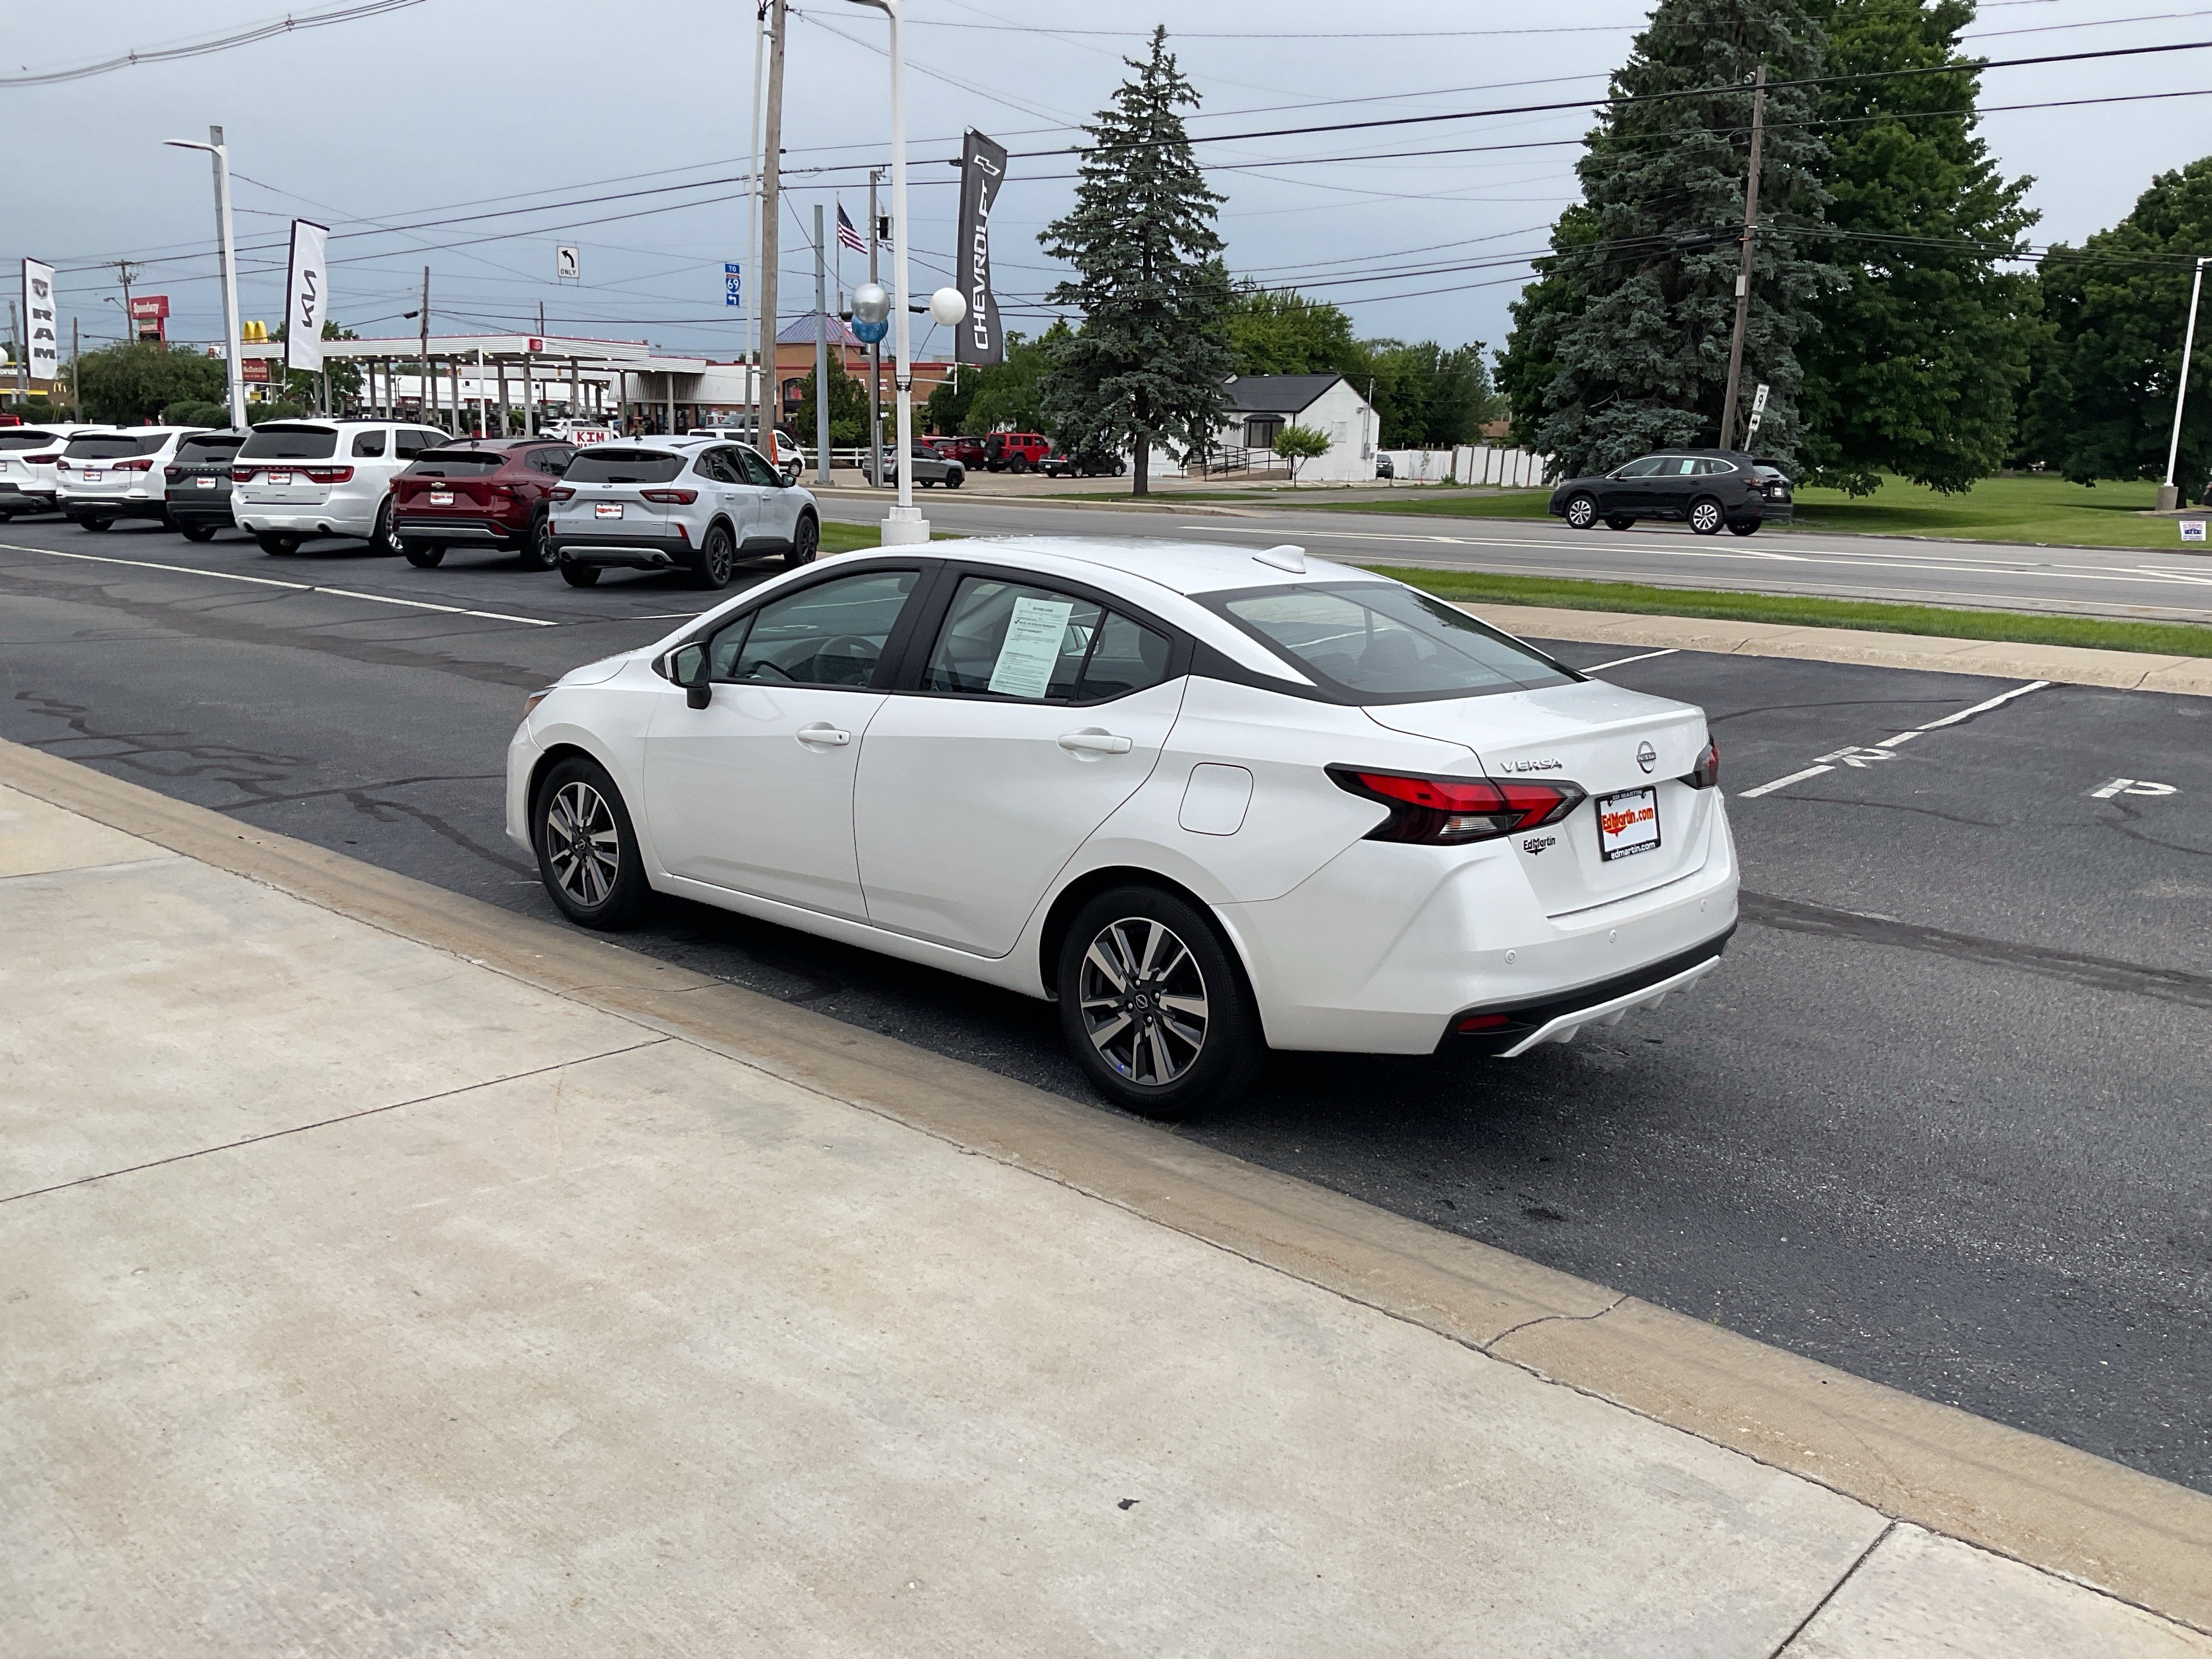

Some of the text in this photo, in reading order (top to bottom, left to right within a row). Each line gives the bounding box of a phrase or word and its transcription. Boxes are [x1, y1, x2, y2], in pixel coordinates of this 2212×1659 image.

[972, 179, 989, 350] CHEVROLET
[727, 279, 739, 290] 69
[133, 301, 160, 316] Speedway
[32, 307, 55, 360] RAM
[1758, 394, 1763, 408] 9
[577, 431, 605, 442] KIM
[1500, 758, 1562, 773] VERSA
[1621, 789, 1642, 799] MARTIN
[1611, 841, 1655, 860] edmartin.com
